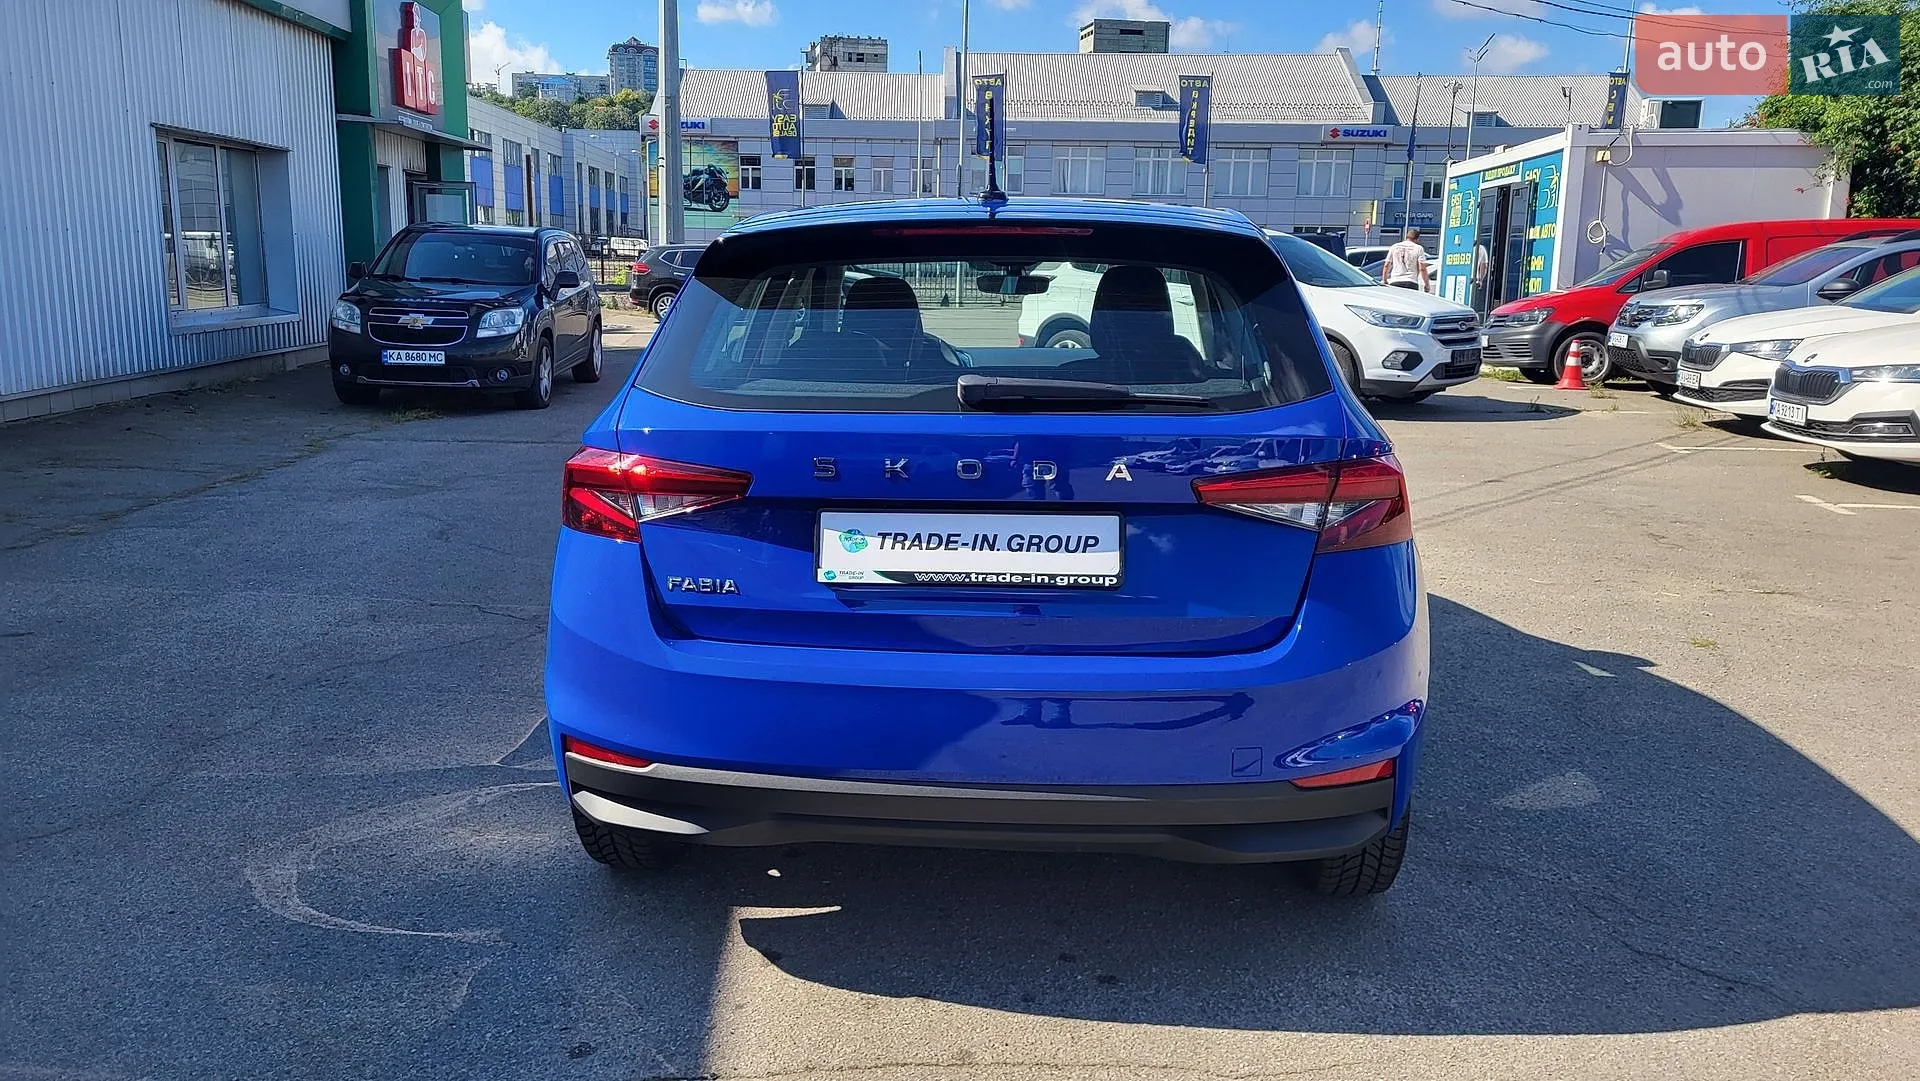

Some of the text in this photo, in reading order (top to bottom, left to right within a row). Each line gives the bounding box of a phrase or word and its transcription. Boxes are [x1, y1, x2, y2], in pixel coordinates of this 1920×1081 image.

[680, 121, 705, 130] ZUKI
[1342, 128, 1388, 138] SUZUKI
[388, 351, 443, 362] KA 8680 MC
[812, 456, 1134, 484] SKODA
[667, 575, 742, 594] FABIA
[914, 572, 1118, 587] www.trade-in.group
